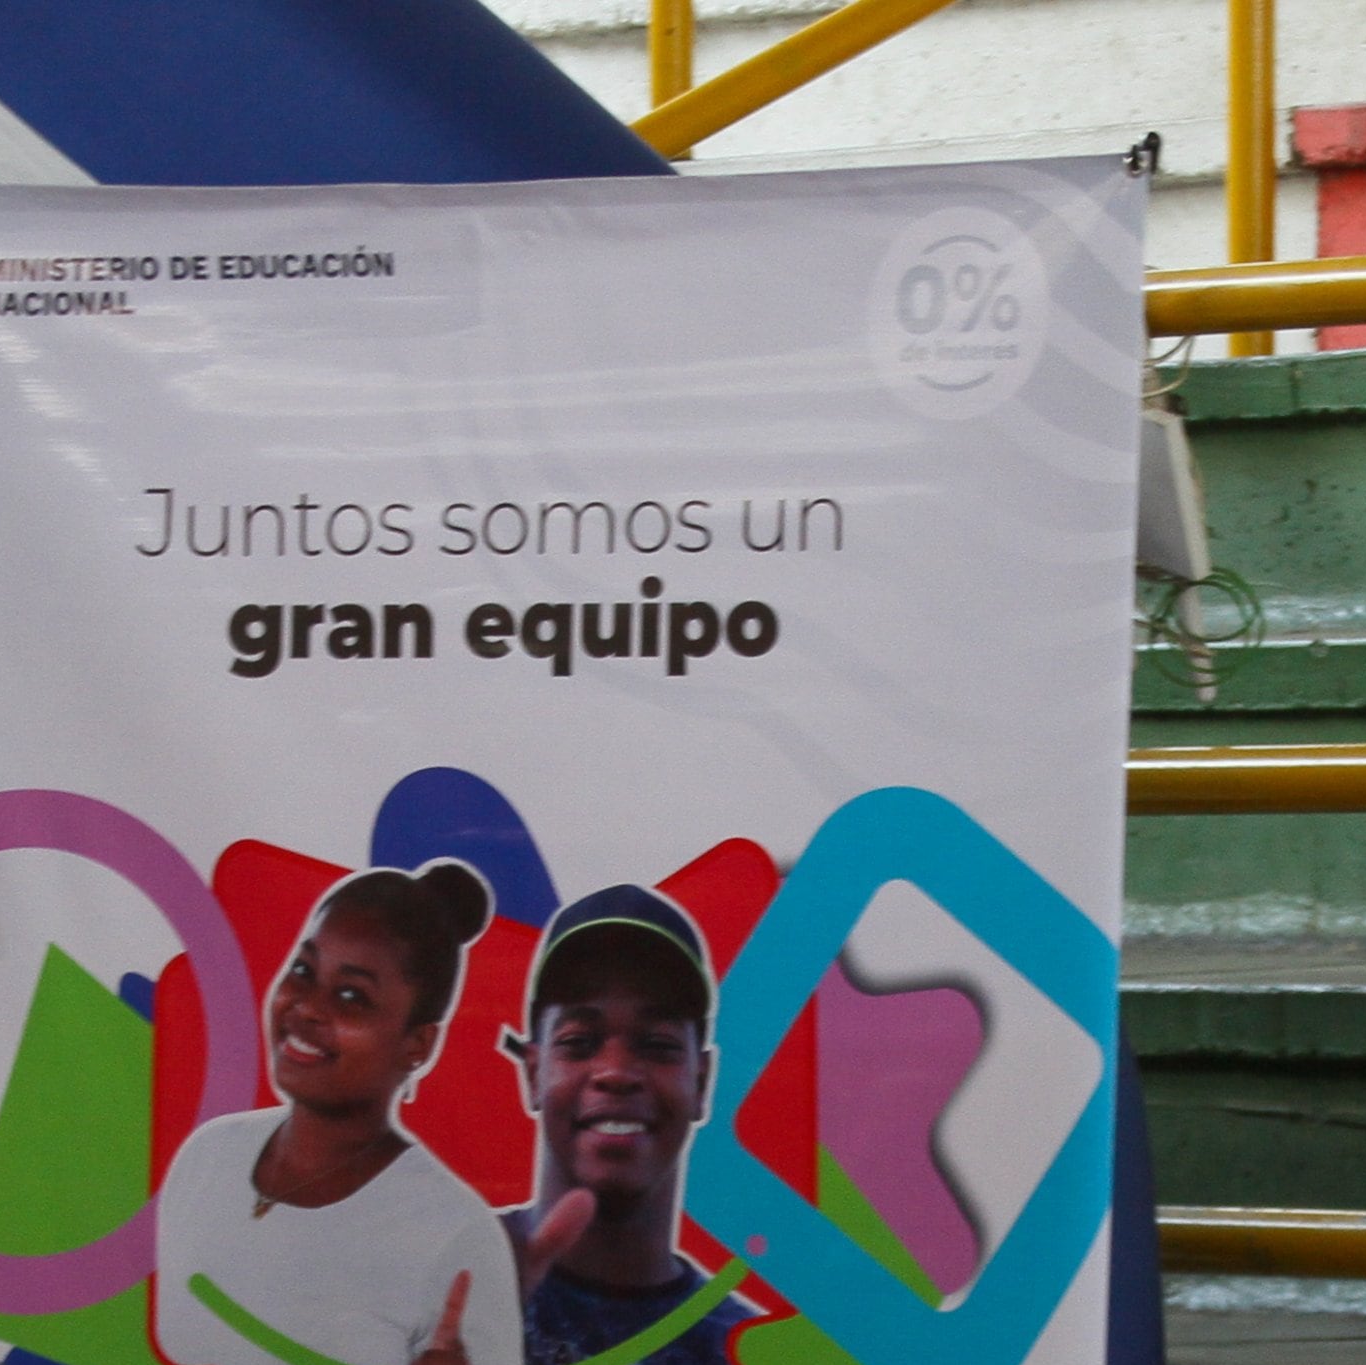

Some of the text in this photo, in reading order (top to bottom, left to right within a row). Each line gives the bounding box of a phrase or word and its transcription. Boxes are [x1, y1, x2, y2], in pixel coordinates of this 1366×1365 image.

[169, 253, 208, 280] DE
[219, 245, 395, 279] EDUCACIÓN
[895, 263, 1021, 335] 0%
[135, 487, 845, 559] Juntos somos un
[228, 575, 780, 678] gran equipo
